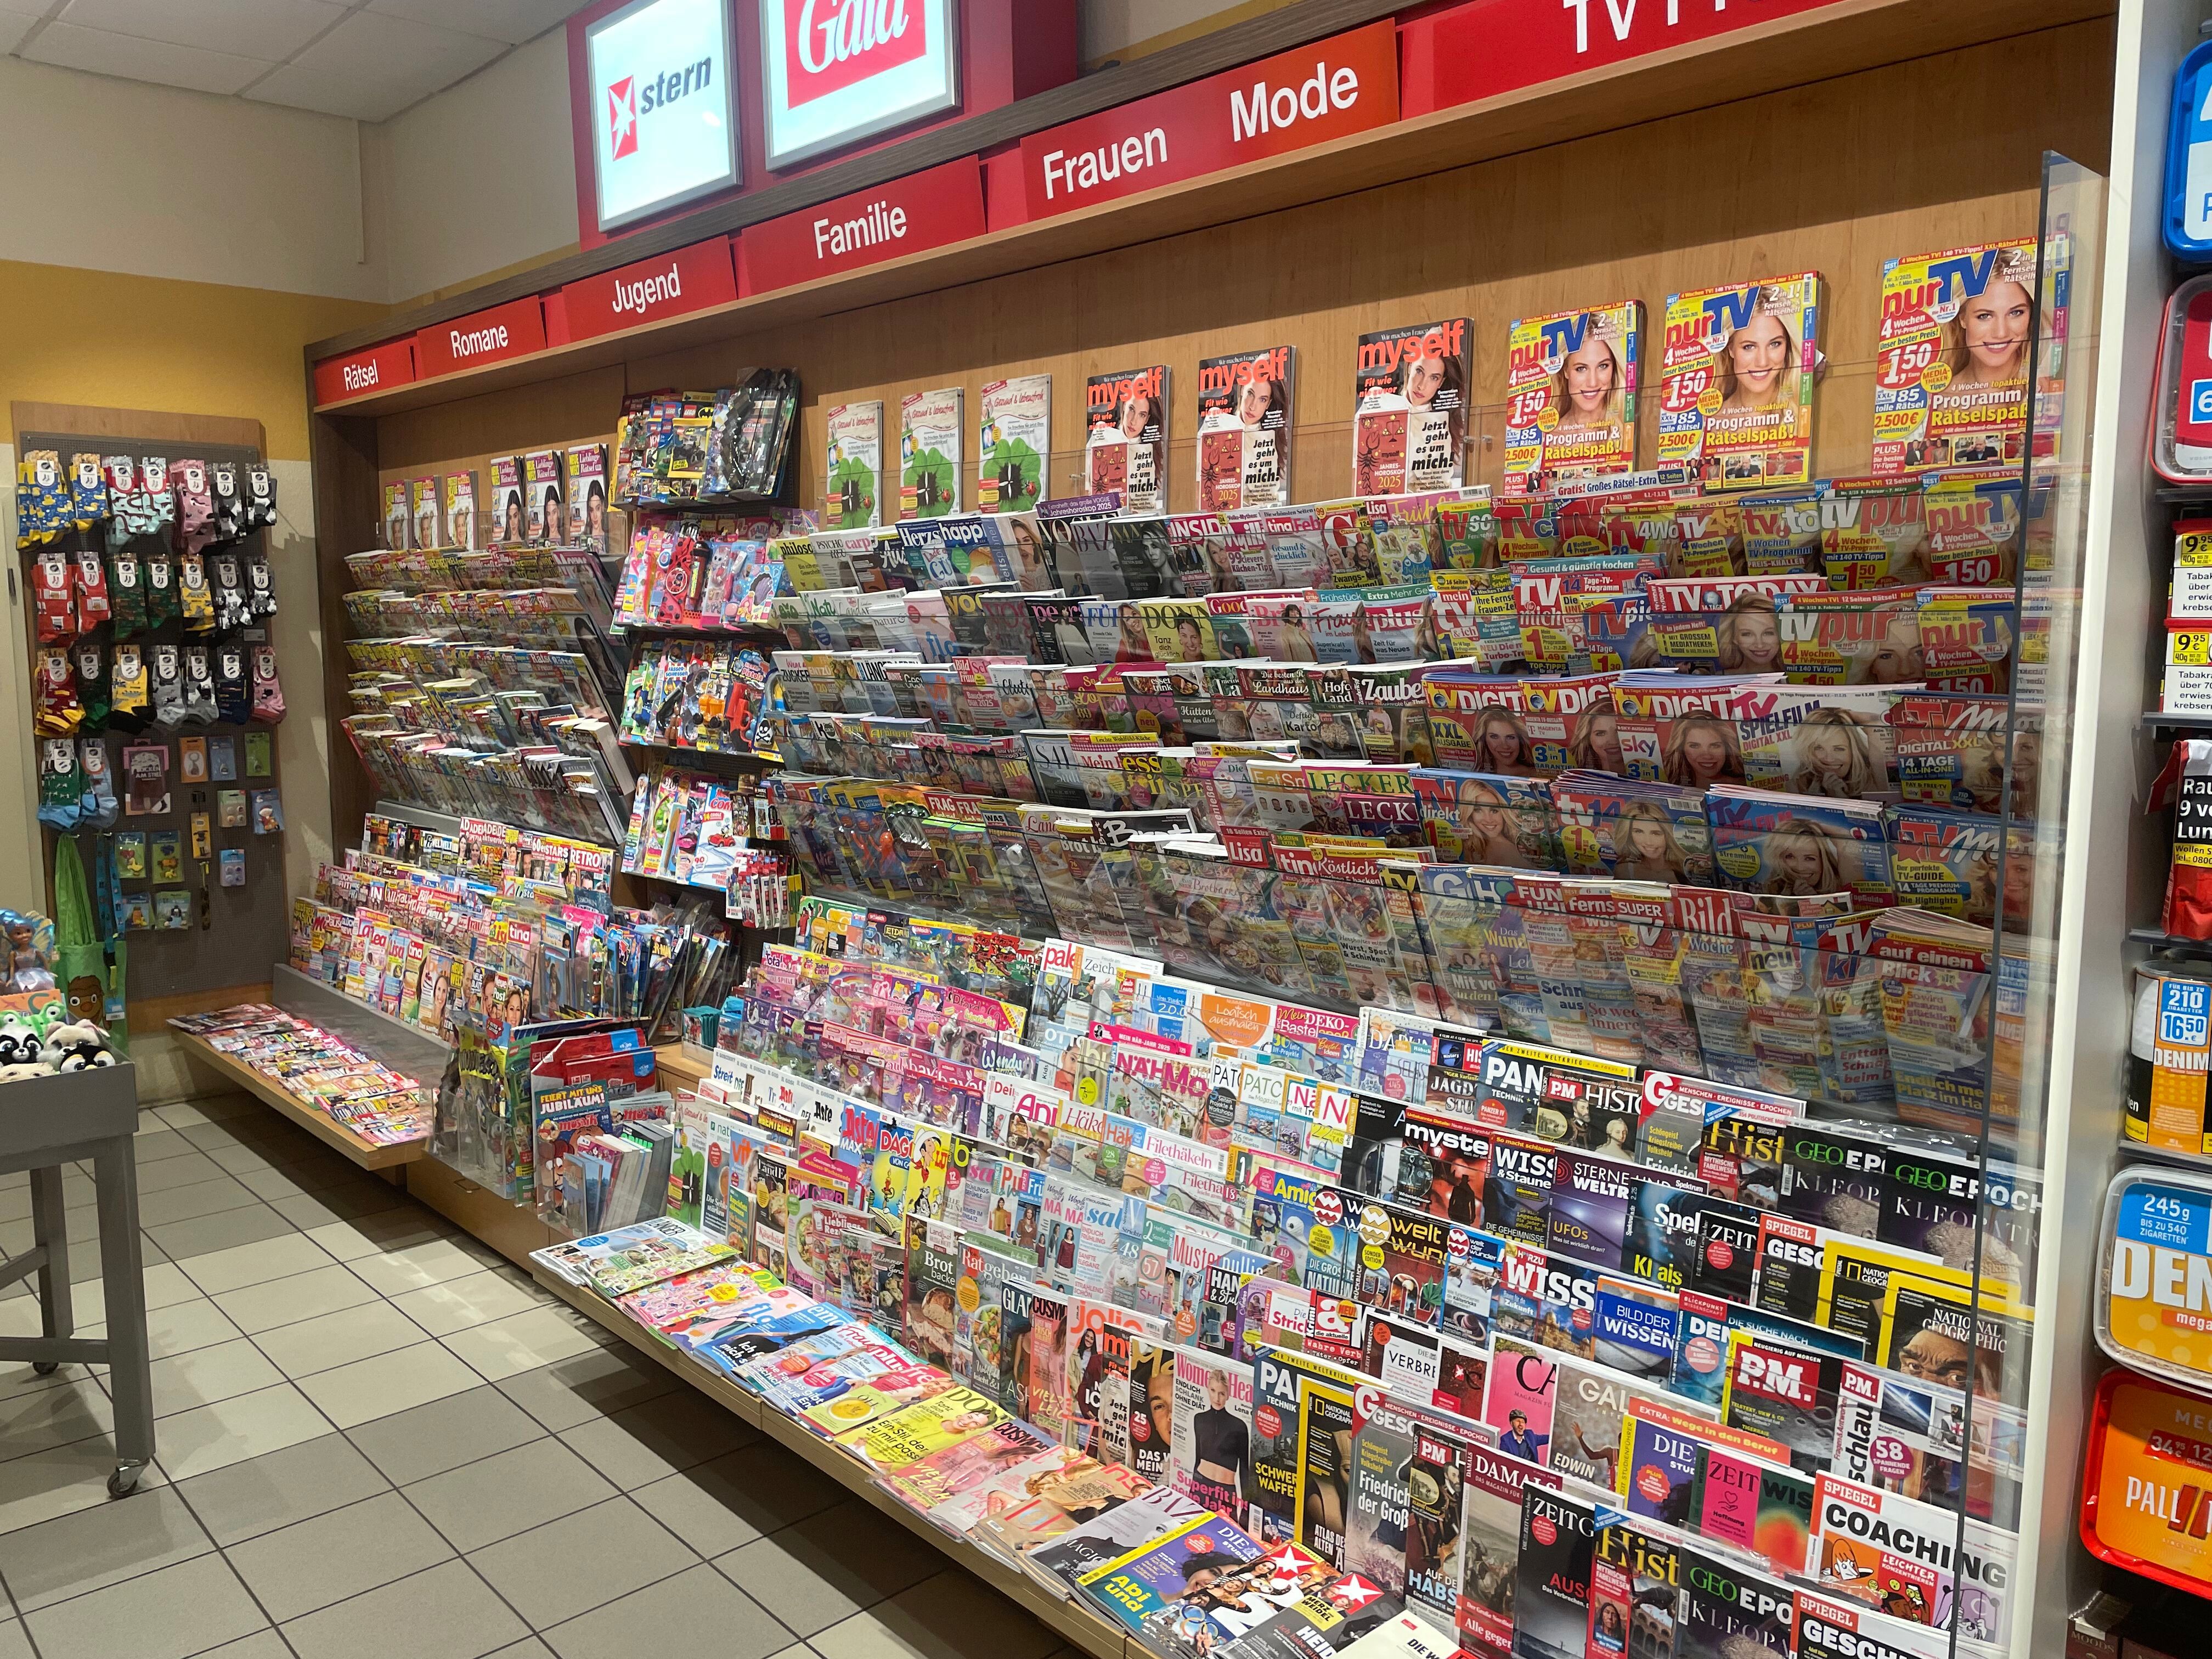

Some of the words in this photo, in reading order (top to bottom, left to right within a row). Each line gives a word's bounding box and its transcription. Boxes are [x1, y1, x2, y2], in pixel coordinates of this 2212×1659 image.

[640, 56, 712, 115] stern
[1043, 127, 1167, 199] Frauen
[1230, 61, 1358, 142] Mode
[814, 200, 907, 258] Familie
[1906, 253, 1929, 262] Wochen
[1954, 245, 1983, 255] TV-Tipps!
[1984, 240, 2017, 250] XXL-Rätsel
[612, 263, 681, 313] Jugend
[1881, 321, 1892, 338] 4
[1894, 315, 1925, 328] Wochen
[1894, 321, 1934, 335] TV-Programm
[450, 325, 508, 358] Romane
[1358, 320, 1465, 370] myself
[1880, 339, 1895, 350] Unser
[1898, 335, 1917, 346] bester
[1919, 330, 1938, 341] Preis!
[344, 360, 378, 391] Rätsel
[1199, 349, 1288, 395] myself
[1087, 368, 1163, 407] myself
[1897, 388, 1920, 401] 85
[1876, 404, 1893, 412] tolle
[1895, 400, 1923, 410] Rätsel
[1933, 390, 2021, 409] Programm
[1422, 421, 1446, 432] Jetzt
[1875, 412, 1918, 428] 2.500€
[1426, 431, 1448, 443] geht
[1877, 426, 1910, 436] gewinnen!
[1415, 445, 1426, 453] es
[1429, 444, 1444, 453] um
[1874, 446, 1900, 454] PLUS!
[1412, 452, 1454, 470] mich!
[1378, 476, 1401, 488] 2025
[1558, 484, 1586, 496] Gratis!
[1587, 481, 1612, 492] Großes
[1613, 476, 1656, 490] Rätsel-Extra
[1049, 505, 1096, 516] Jahreshoroskop
[1365, 500, 1387, 516] Lisa
[1267, 519, 1291, 533] tina
[1569, 562, 1600, 572] günstig
[1602, 559, 1634, 569] kochen
[1321, 592, 1361, 602] Frühstück
[1442, 592, 1469, 601] mein
[1370, 608, 1424, 630] plus
[2176, 654, 2187, 662] 40g
[1432, 722, 1460, 740] XXL
[1622, 739, 1656, 760] sky
[1898, 741, 1951, 753] DIGITAL
[1953, 737, 1981, 749] XXL
[1900, 759, 1914, 768] 14
[1918, 757, 1954, 767] TAGE
[1309, 772, 1413, 794] LECKER
[1420, 808, 1460, 822] direkt
[2180, 800, 2191, 816] 9
[546, 844, 568, 857] STARS
[1229, 839, 1262, 862] Lisa
[2176, 845, 2204, 854] Wollen
[569, 850, 600, 871] RETRO
[1318, 859, 1378, 876] Köstlich
[1898, 872, 1944, 881] TV-GUIDE
[1620, 904, 1661, 917] SUPER
[1678, 896, 1735, 942] Bild
[1340, 942, 1367, 953] Wurst,
[1368, 946, 1393, 956] Speck
[1690, 937, 1734, 955] Woche
[1352, 951, 1386, 963] Schinken
[2169, 990, 2203, 1009] 210
[1216, 1004, 1256, 1020] Logisch
[1306, 1012, 1349, 1029] DEKO-
[1210, 1014, 1259, 1033] ausmalen
[1517, 1048, 1541, 1058] ZWEITE
[1545, 1053, 1582, 1065] WELTKRIEG
[2153, 1047, 2208, 1070] DENIM
[541, 1092, 567, 1103] FEIERT
[569, 1089, 584, 1099] MIT
[586, 1086, 603, 1096] UNS
[541, 1093, 605, 1114] JUBILÄUM!
[1492, 1089, 1523, 1103] TECHNIK
[1679, 1086, 1712, 1097] MENSCHEN
[1717, 1093, 1756, 1108] EREIGNISSE
[1760, 1103, 1793, 1116] EPOCHEN
[559, 1114, 599, 1131] mosaik
[1146, 1135, 1212, 1169] Filethäkeln
[1795, 1140, 1843, 1165] GEO
[1574, 1162, 1629, 1186] STERNE
[1895, 1164, 1946, 1190] GEO
[2144, 1193, 2190, 1221] 245g
[1392, 1217, 1442, 1243] welt
[1499, 1225, 1544, 1242] GEHEIMNISSE
[1554, 1222, 1588, 1240] UFOs
[1766, 1221, 1810, 1239] SPIEGEL
[2141, 1218, 2153, 1227] BIS
[2155, 1222, 2166, 1231] ZU
[2168, 1223, 2187, 1235] 540
[2140, 1228, 2187, 1244] ZIGARETTEN
[925, 1250, 954, 1274] Brot
[1635, 1255, 1652, 1275] KI
[1658, 1265, 1683, 1284] als
[1504, 1299, 1534, 1315] Zukunft
[1684, 1296, 1723, 1312] BLICKPUNKT
[1617, 1304, 1643, 1321] BILD
[1645, 1311, 1670, 1326] DER
[1737, 1350, 1812, 1402] P.M.
[1176, 1378, 1201, 1395] ENDLICH
[1176, 1386, 1204, 1403] SCHLANK
[1845, 1372, 1876, 1399] P.M.
[1175, 1393, 1193, 1404] OHNE
[1192, 1398, 1205, 1410] DIÄT
[1876, 1440, 1904, 1460] 58
[1554, 1453, 1595, 1479] EDWIN
[1873, 1458, 1910, 1470] SPANNENDE
[1880, 1466, 1904, 1475] FRAGEN
[1709, 1461, 1759, 1492] ZEIT
[1360, 1471, 1410, 1506] Friedrich
[1824, 1481, 1876, 1508] SPIEGEL
[2125, 1476, 2181, 1524] PALL
[1358, 1493, 1377, 1514] der
[1380, 1500, 1409, 1530] Groß
[1826, 1504, 2006, 1588] COACHING
[1882, 1563, 1934, 1587] KONZENTRIEREN
[1883, 1555, 1934, 1582] LEICHTER
[1305, 1595, 1327, 1610] MERZ
[1303, 1602, 1331, 1622] WEIDEL
[2071, 1630, 2115, 1653] MOODS
